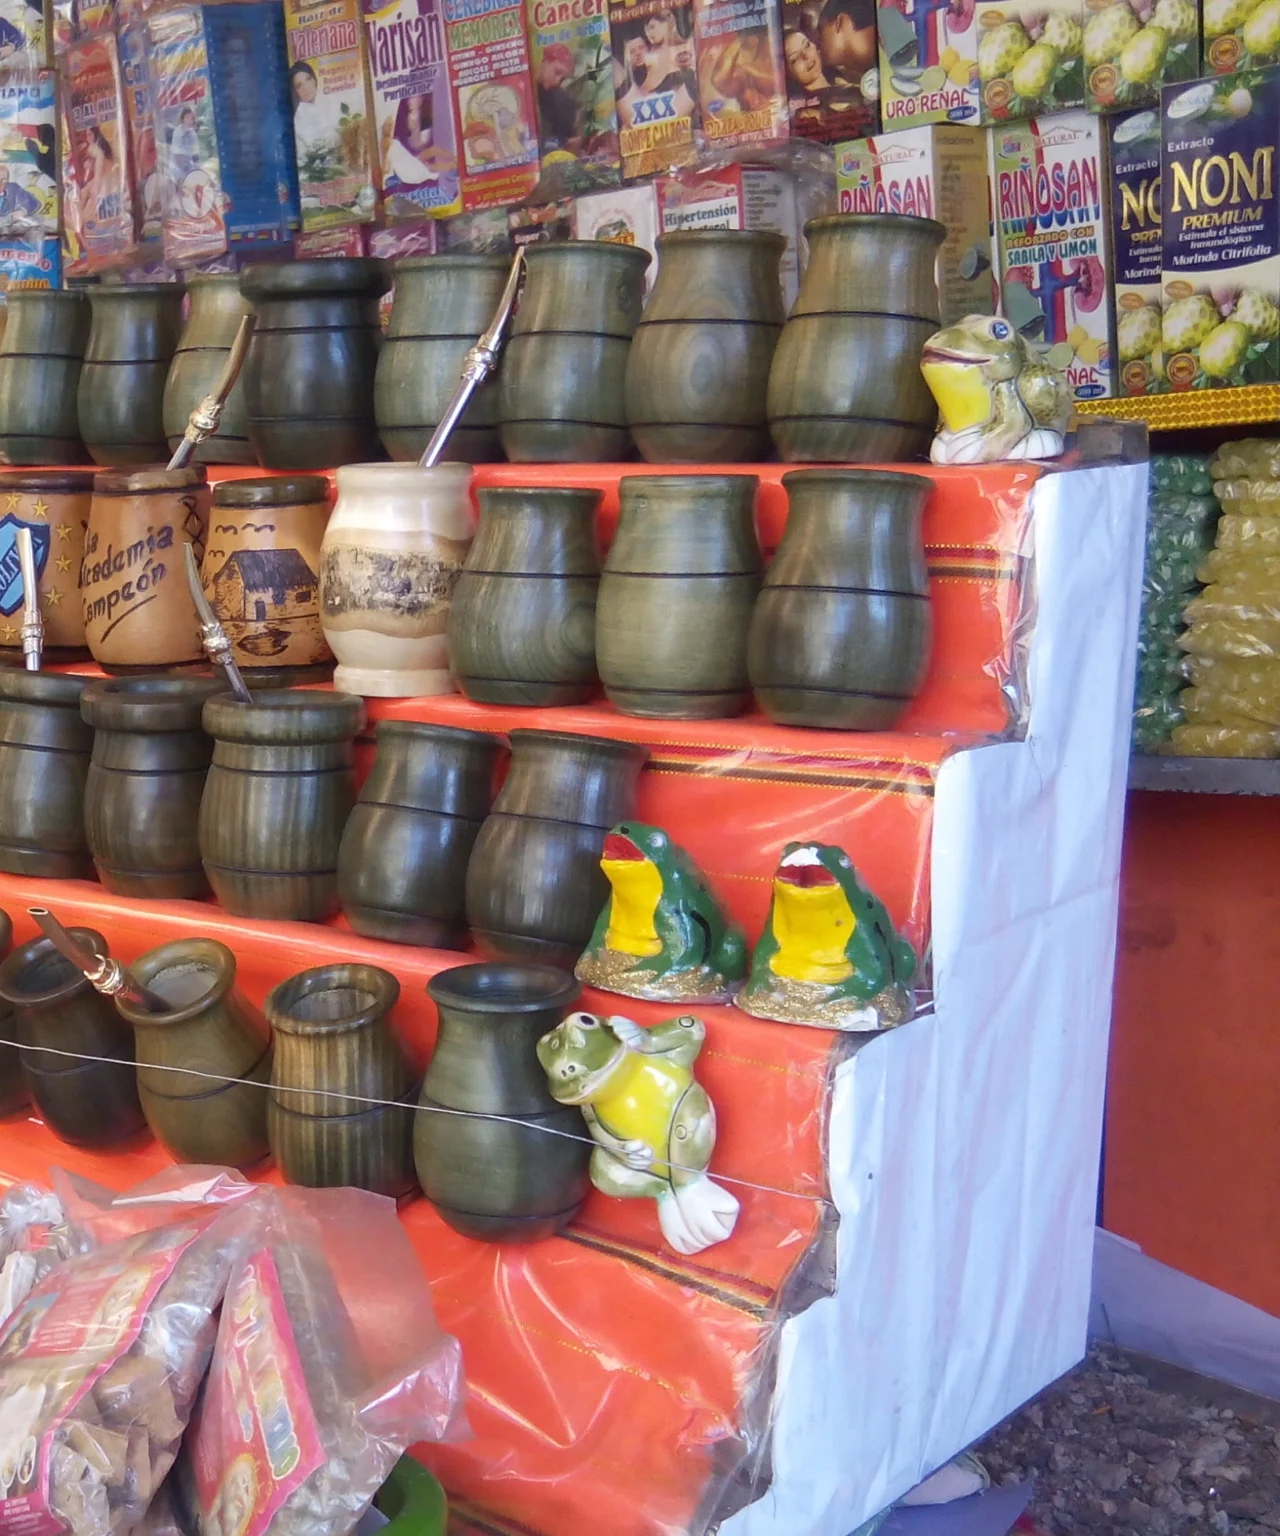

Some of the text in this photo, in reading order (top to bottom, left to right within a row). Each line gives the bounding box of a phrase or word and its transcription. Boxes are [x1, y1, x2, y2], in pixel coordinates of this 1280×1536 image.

[534, 0, 603, 28] Cancer
[290, 20, 357, 60] Valeriana
[448, 9, 523, 49] MEMOREX
[369, 12, 444, 77] Varisan
[632, 94, 676, 124] XXX
[886, 98, 916, 119] URO
[1167, 137, 1215, 152] Extracto
[1116, 159, 1158, 175] Extracto
[1170, 146, 1275, 212] NONI
[840, 174, 933, 219] RIÑOSAN
[1000, 156, 1099, 222] RIÑOSAN
[664, 203, 737, 226] Hipertensión
[1119, 176, 1162, 230] NO
[1182, 206, 1263, 231] PREMIUM
[1006, 226, 1094, 248] REFORZADO CON
[1179, 229, 1216, 242] Estimula
[1229, 223, 1265, 235] sistema
[1008, 239, 1098, 266] SABILA Y LIMON
[1172, 253, 1218, 266] Morinda
[1221, 245, 1272, 260] Citrifolia
